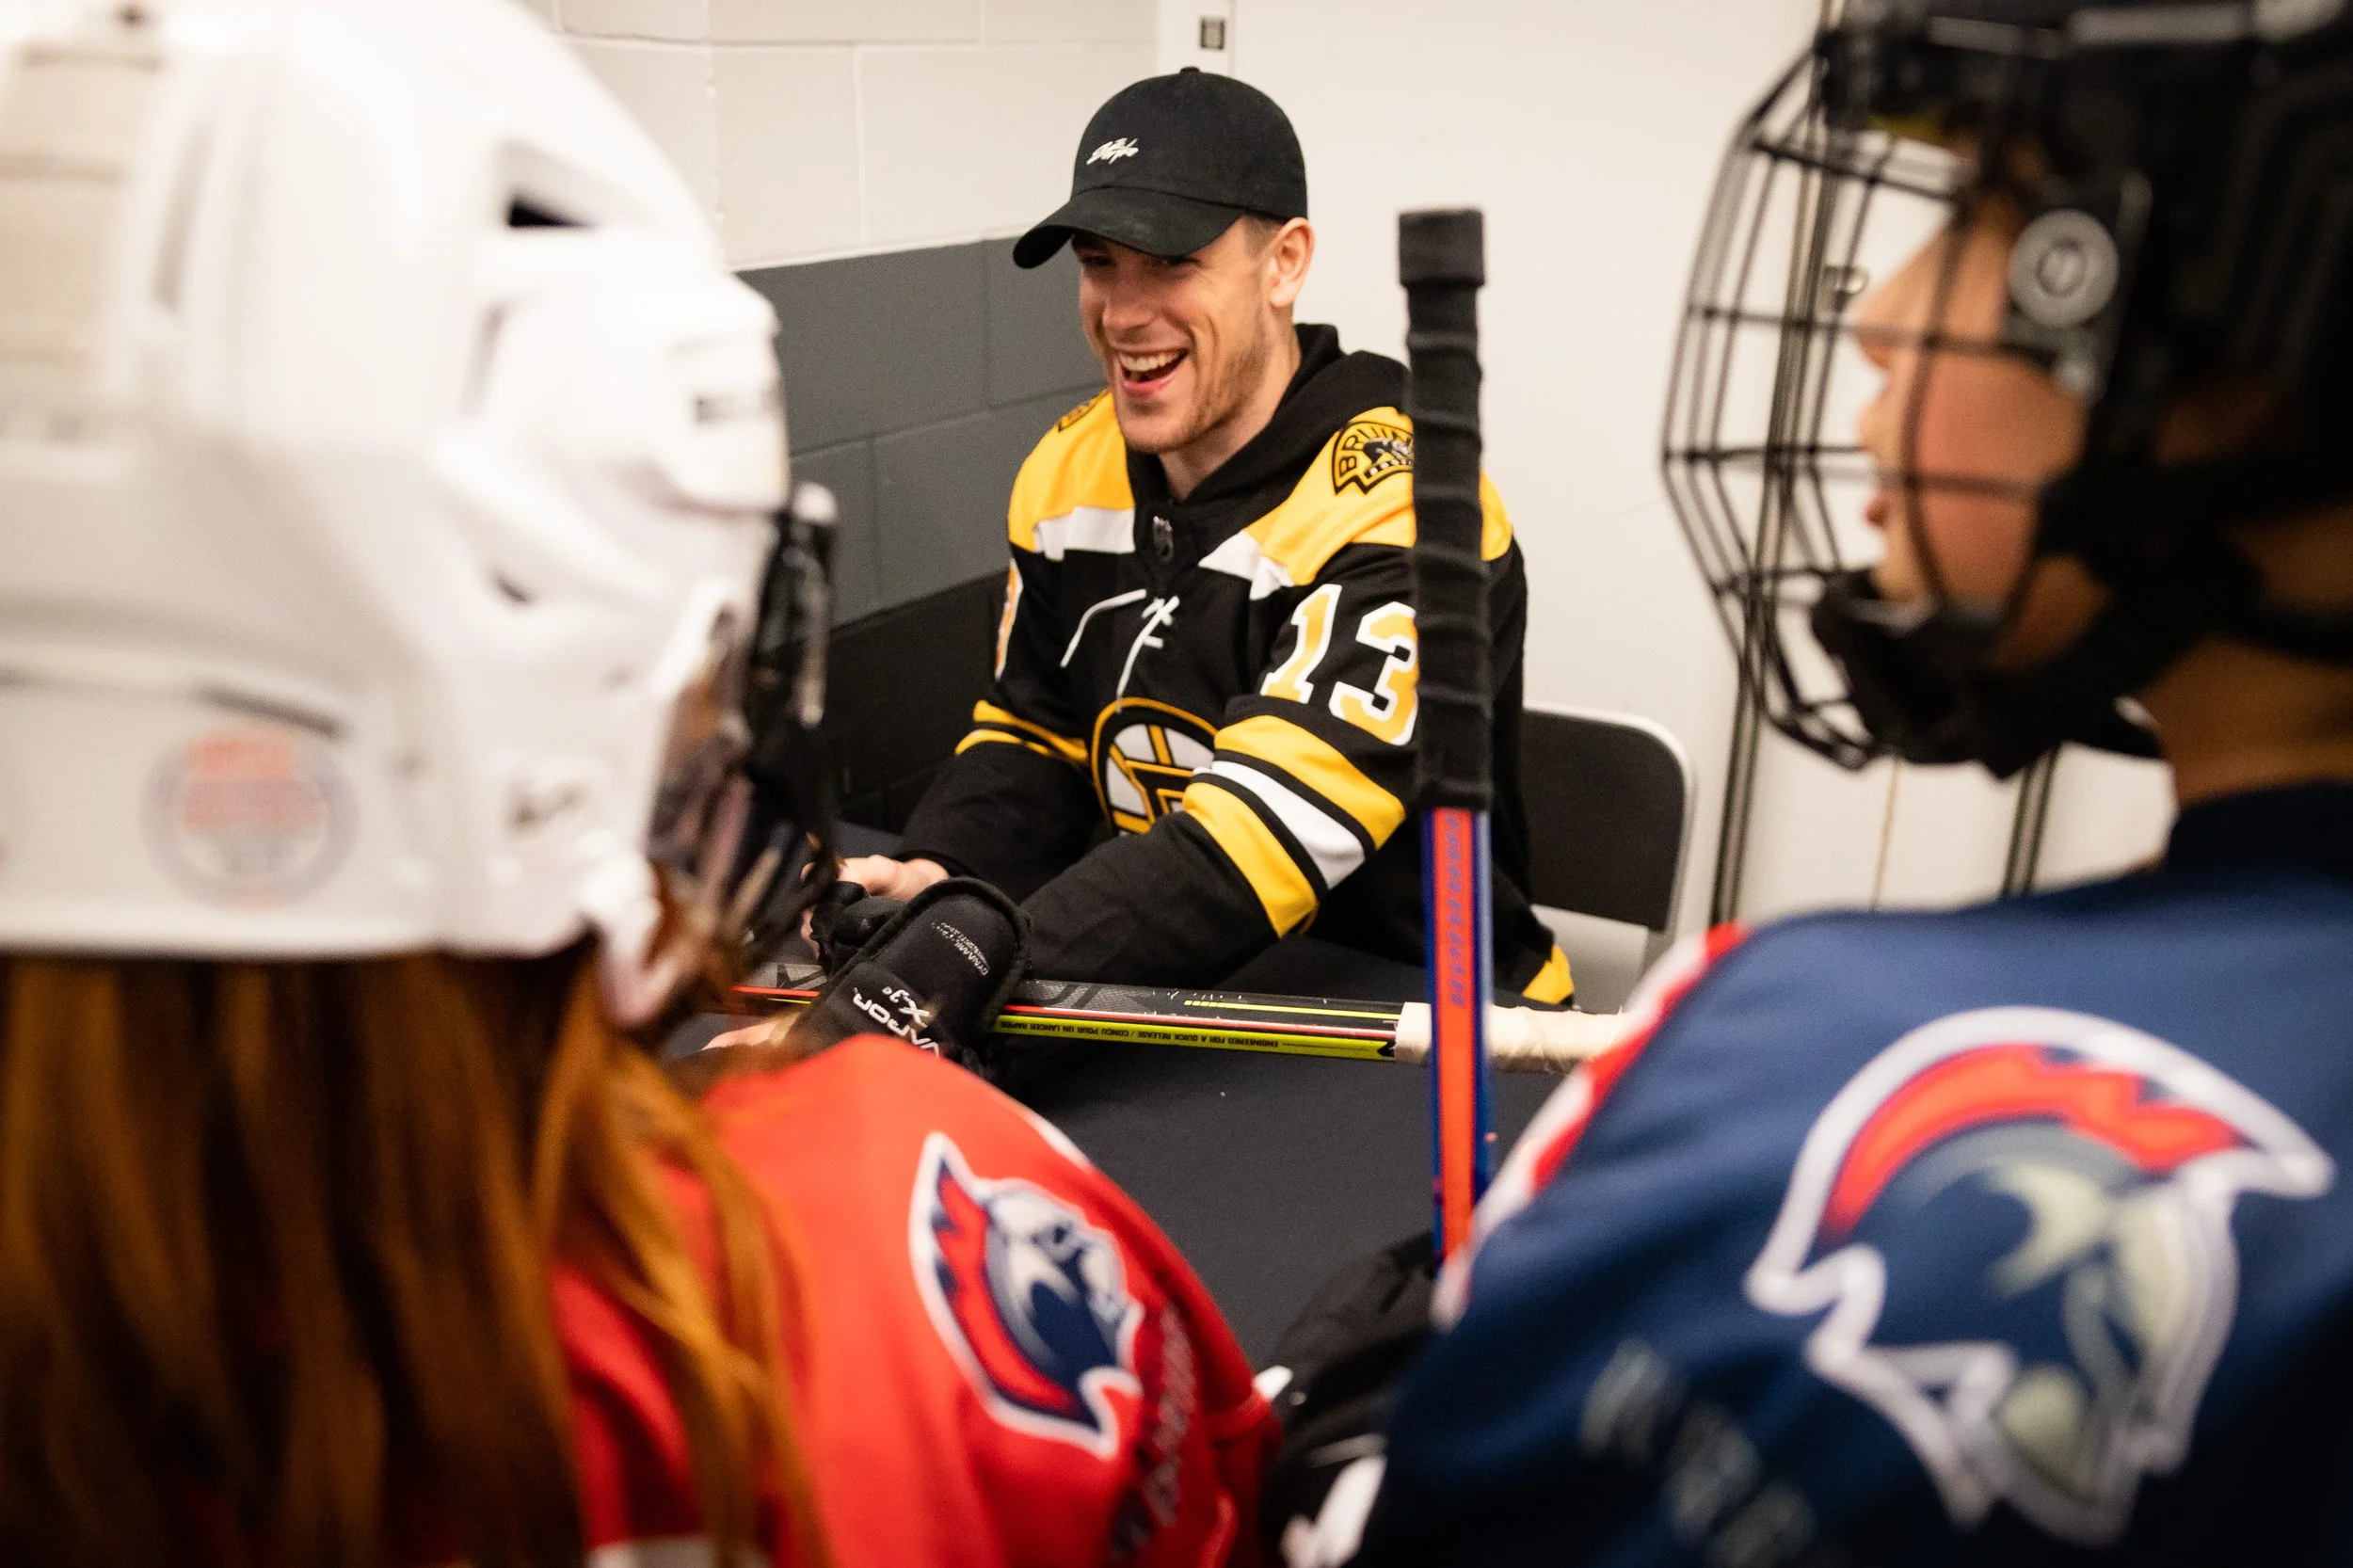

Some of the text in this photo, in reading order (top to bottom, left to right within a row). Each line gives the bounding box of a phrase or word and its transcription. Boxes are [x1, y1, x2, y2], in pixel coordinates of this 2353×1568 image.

[1339, 426, 1411, 477] BRUIN
[1260, 584, 1419, 745] 13
[853, 992, 940, 1058] VAPOR
[1031, 1023, 1060, 1032] LANCER
[1062, 1024, 1074, 1033] UN
[1077, 1026, 1098, 1034] POUR
[1137, 1031, 1171, 1040] RELEASE
[1175, 1032, 1198, 1042] QUICK
[1227, 1037, 1279, 1048] ENGINEERED
